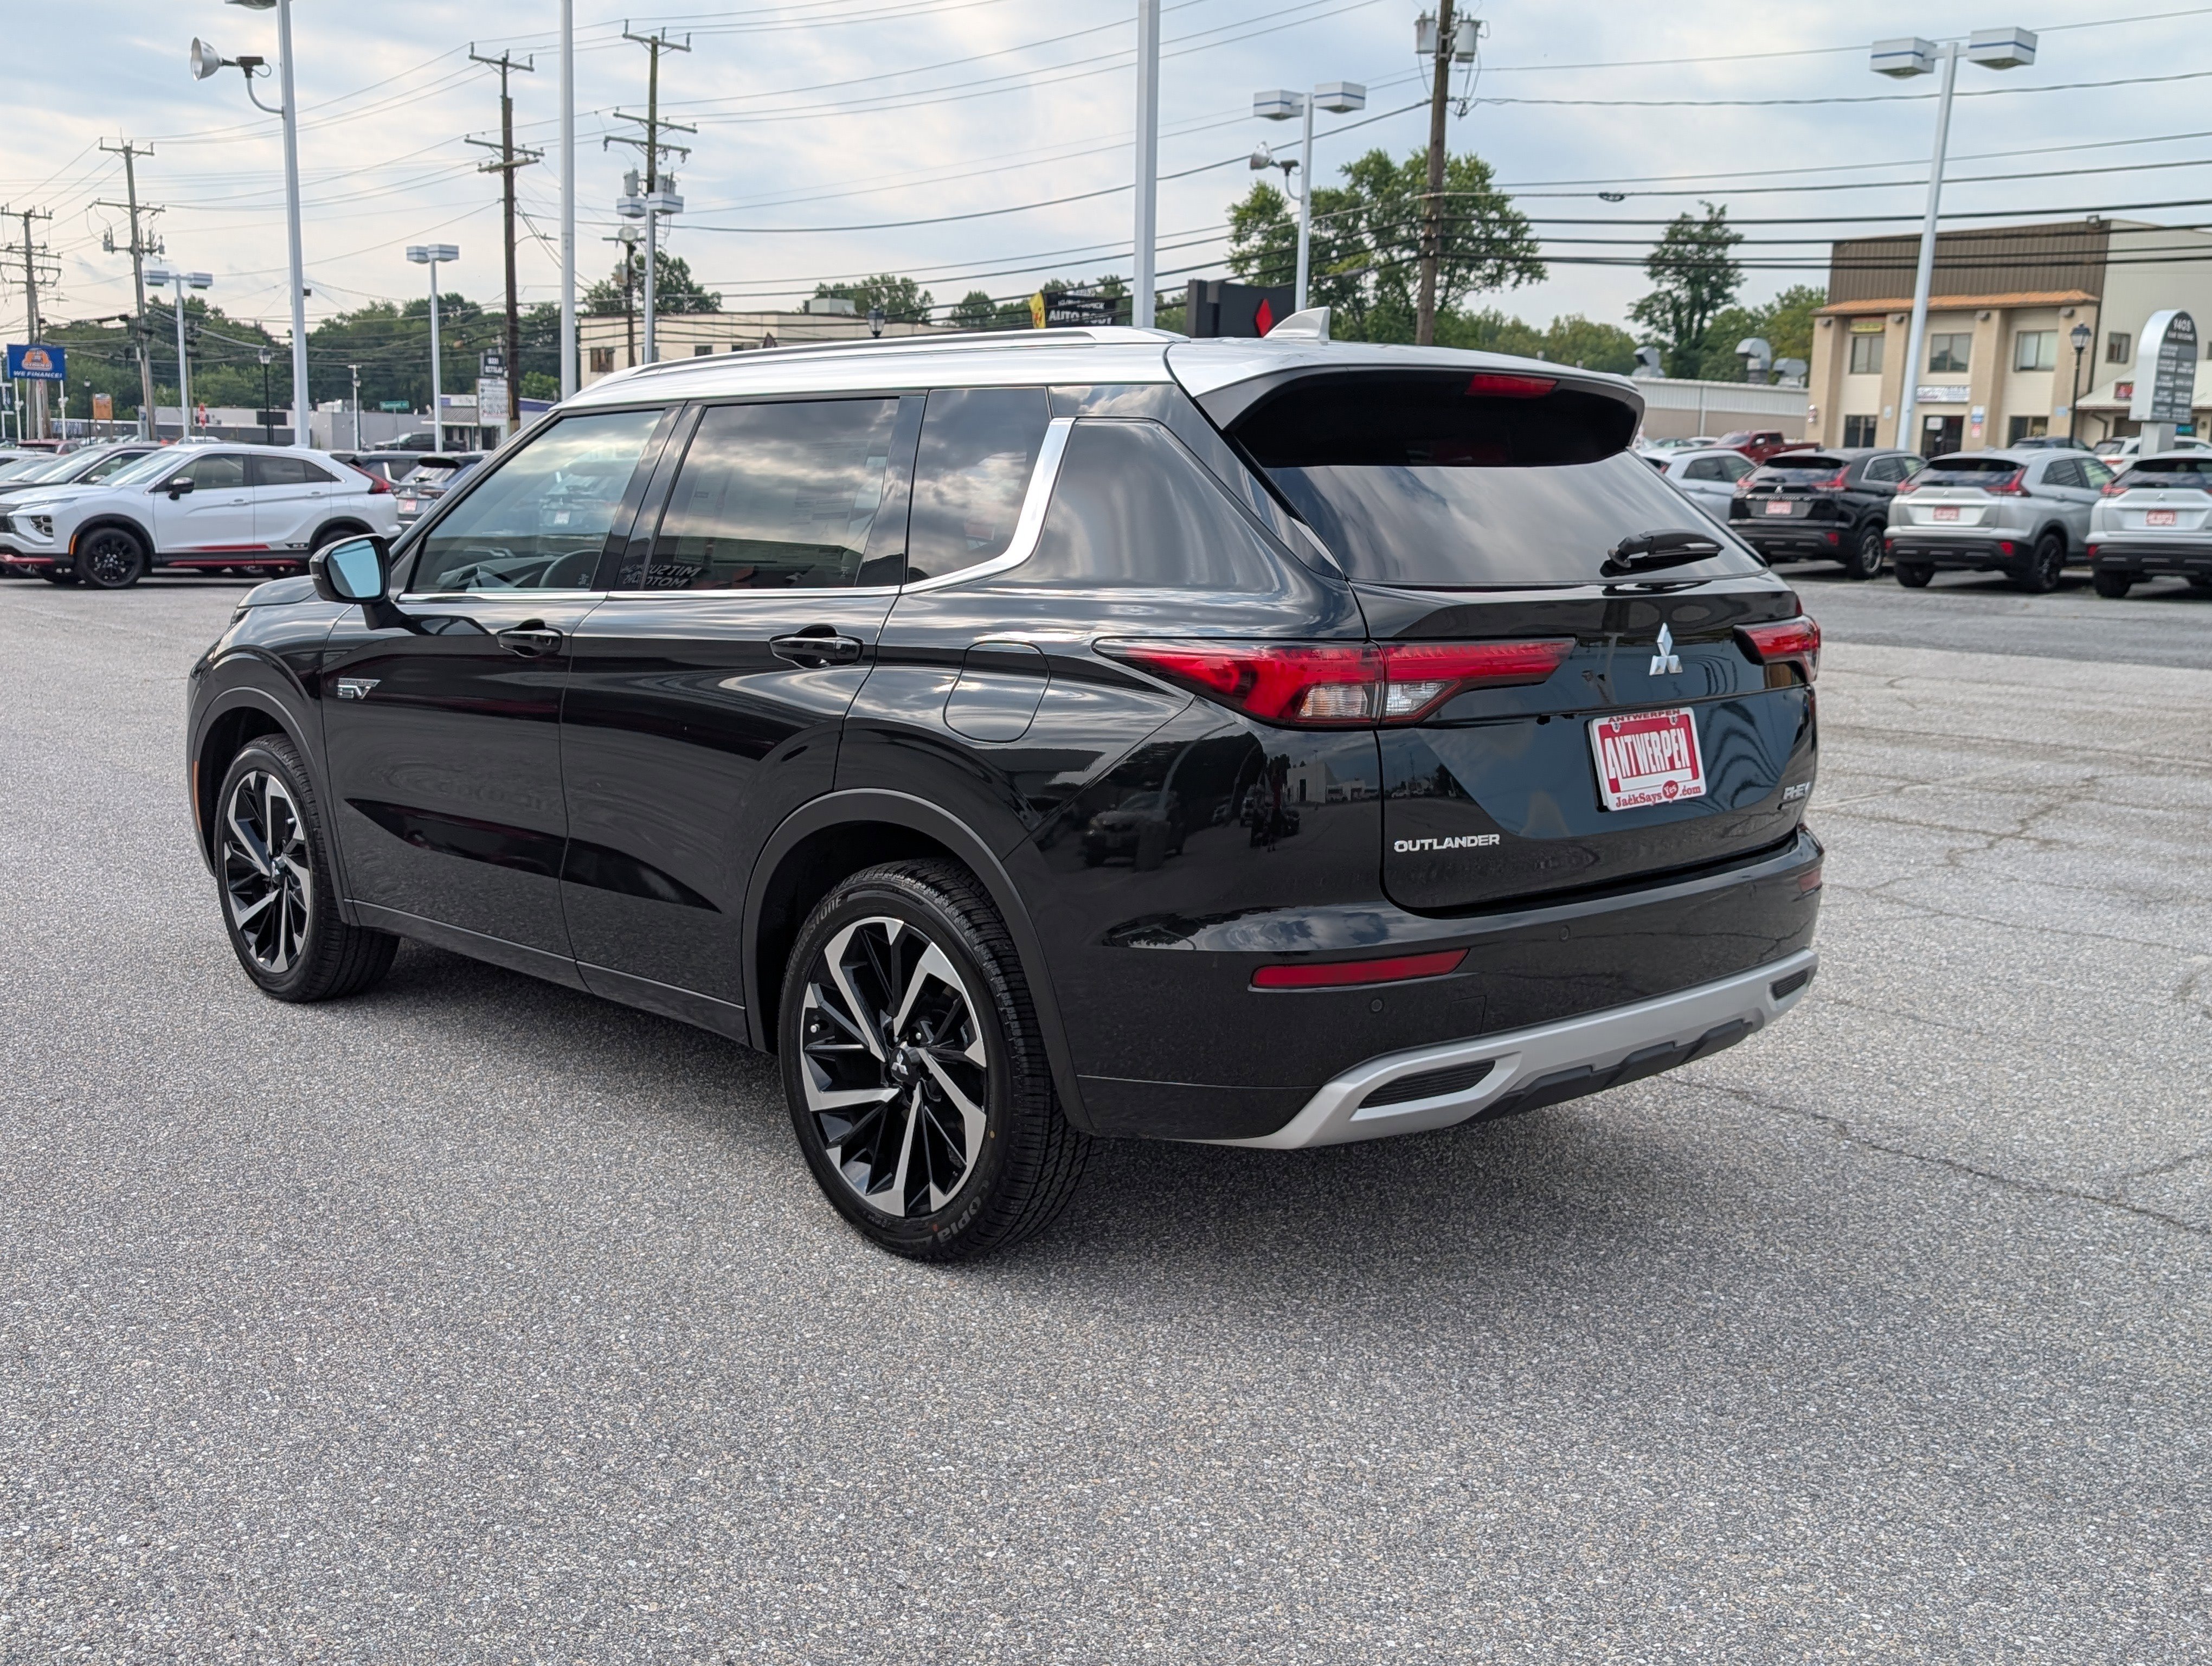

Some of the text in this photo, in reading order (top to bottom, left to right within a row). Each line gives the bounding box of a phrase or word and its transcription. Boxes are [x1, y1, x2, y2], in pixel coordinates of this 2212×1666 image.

[1049, 310, 1080, 321] AUTO
[1608, 709, 1680, 723] ANTWERPEN
[1604, 727, 1691, 780] ANTWERPEN
[1394, 834, 1501, 853] OUTLANDER
